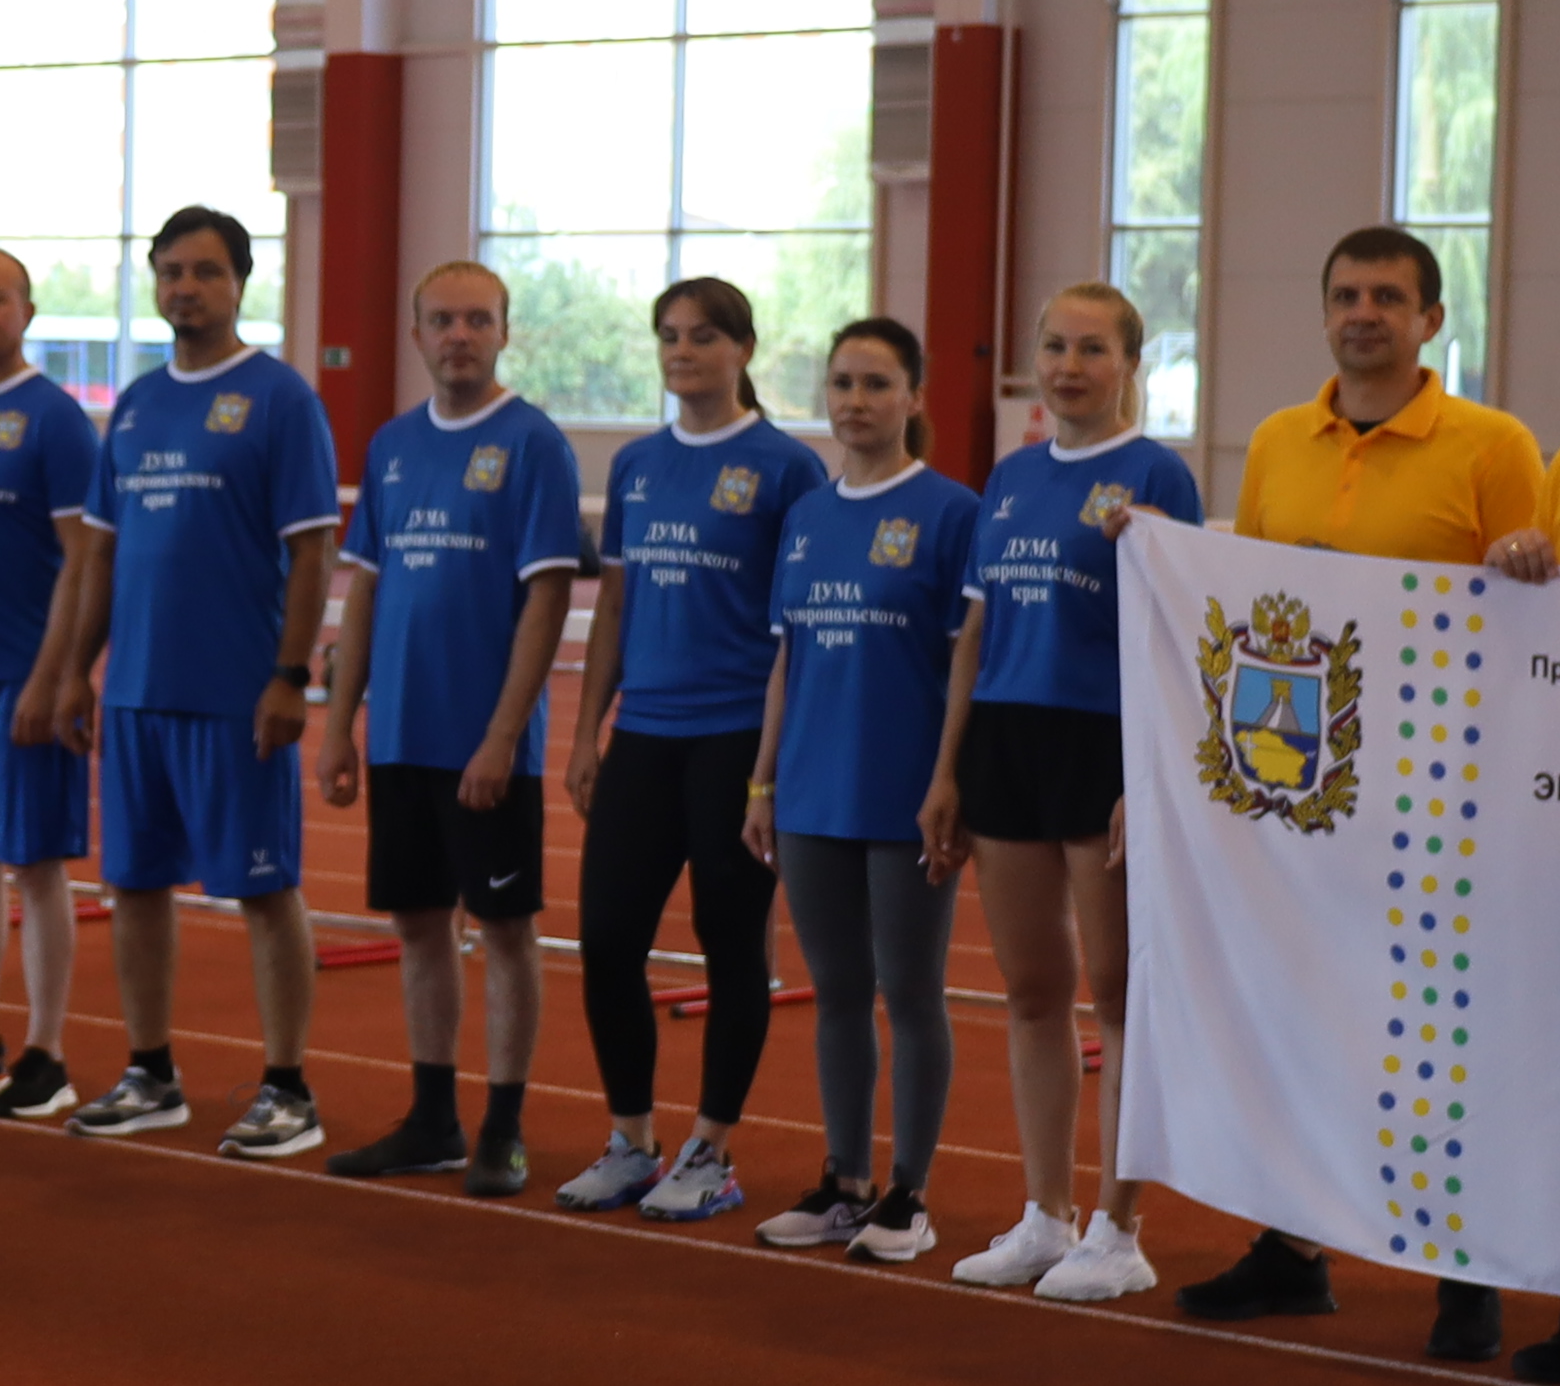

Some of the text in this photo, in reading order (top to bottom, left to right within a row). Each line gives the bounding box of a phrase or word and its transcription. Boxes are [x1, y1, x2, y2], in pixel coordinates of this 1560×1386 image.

[405, 509, 448, 530] ДУМА
[644, 521, 698, 543] ДУМА
[1001, 537, 1059, 561] ДУМА
[650, 568, 687, 587] края
[807, 581, 863, 605] ДУМА
[1011, 586, 1048, 607] края
[816, 629, 855, 650] края
